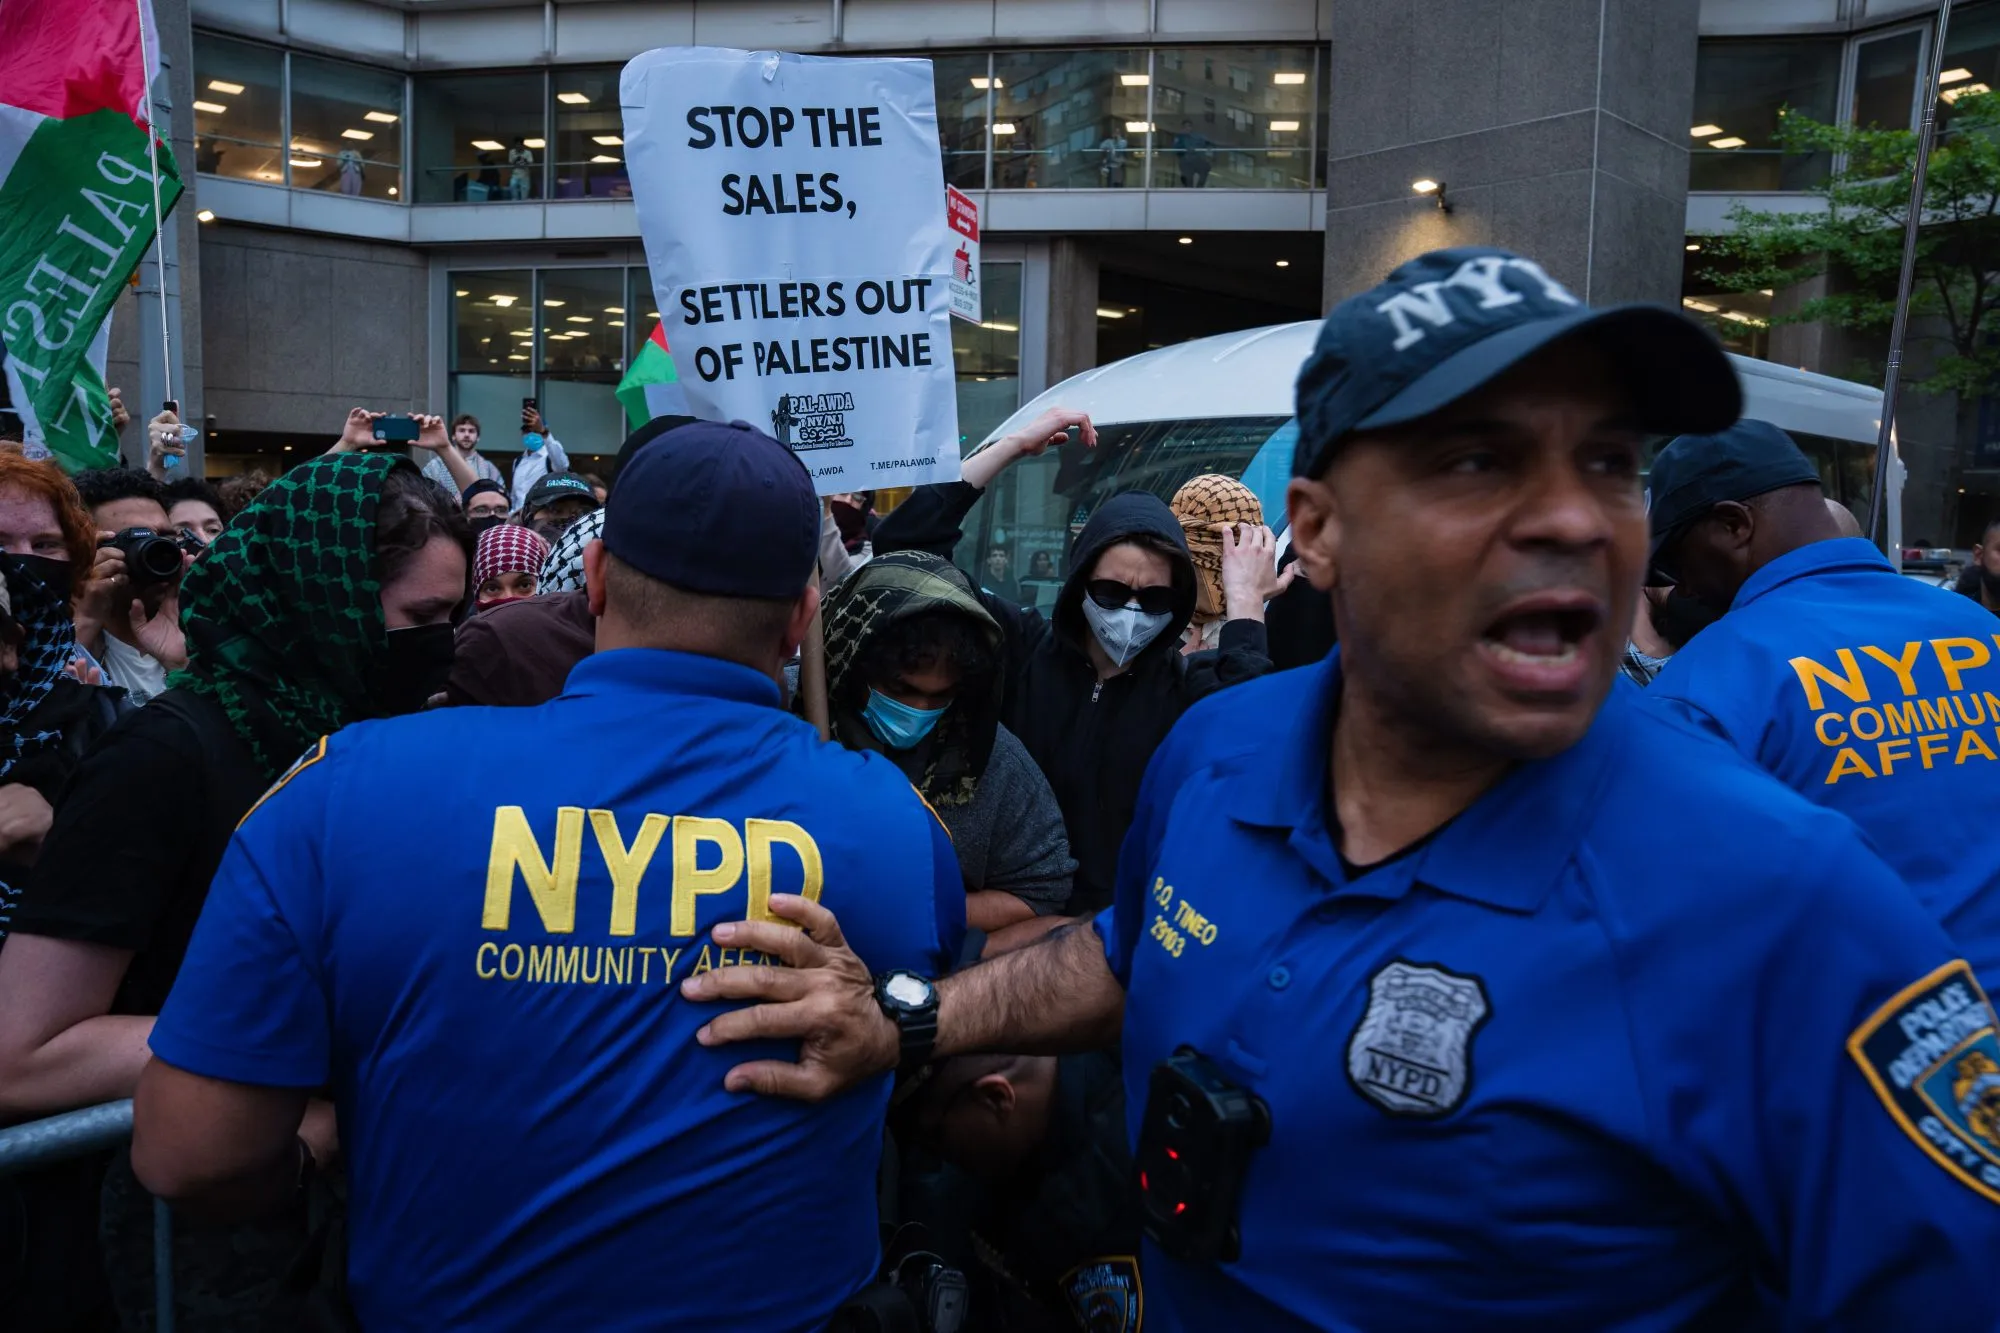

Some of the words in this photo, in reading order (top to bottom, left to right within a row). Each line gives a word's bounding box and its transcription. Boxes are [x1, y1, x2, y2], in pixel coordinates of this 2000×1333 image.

[686, 106, 794, 150] STOP
[801, 107, 882, 148] THE
[721, 172, 857, 220] SALES,
[680, 281, 846, 326] SETTLERS
[855, 279, 932, 316] OUT
[695, 343, 743, 383] OF
[753, 333, 932, 377] PALESTINE
[788, 392, 854, 414] PAL-AWDA
[806, 413, 843, 428] NY/NJ
[799, 425, 845, 441] العودة
[870, 456, 937, 471] T.ME/PALAWDA
[1788, 634, 2000, 711] NYP
[481, 805, 824, 937] NYPD
[1174, 899, 1217, 946] TINEO
[476, 942, 682, 985] COMMUNITY
[1367, 1053, 1442, 1097] NYPD
